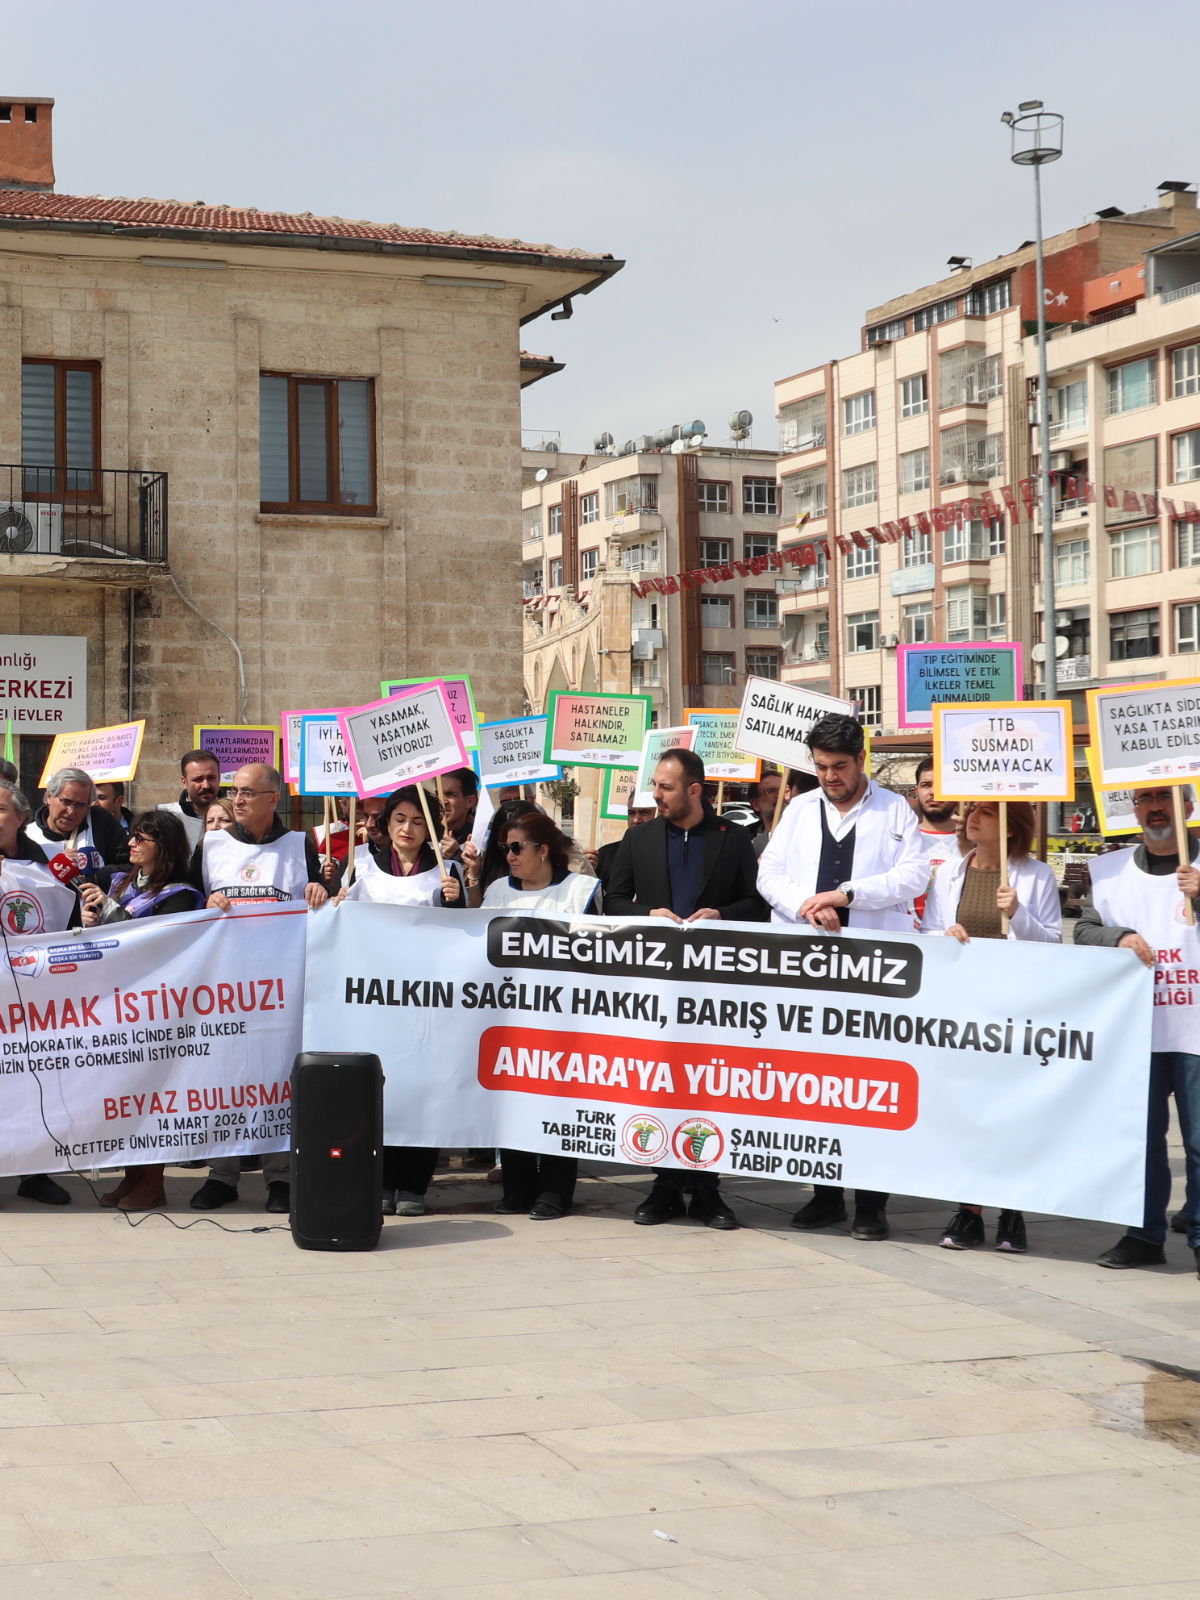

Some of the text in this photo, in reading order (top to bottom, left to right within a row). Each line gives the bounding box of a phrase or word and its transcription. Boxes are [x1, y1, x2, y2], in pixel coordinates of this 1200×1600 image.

[923, 652, 997, 664] TIP EĞİTİMİNDE
[919, 665, 1001, 677] BİLİMSEL VE ETİK
[924, 679, 995, 690] İLKELER TEMEL
[750, 693, 794, 715] SAĞLIK
[930, 692, 991, 702] ALINMALIDIR
[369, 703, 425, 729] YAŞAMAK,
[571, 704, 630, 717] HASTANELER
[1110, 701, 1172, 719] SAĞLIKTA
[372, 718, 431, 746] YAŞATMAK
[574, 718, 626, 732] HALKINDIR,
[988, 718, 1015, 732] TTB
[1114, 722, 1148, 736] YASA
[319, 727, 333, 740] İYİ
[494, 726, 535, 740] SAĞLIKTA
[570, 731, 628, 745] SATILAMAZ!
[205, 737, 268, 745] HAYATLARIMIZDAN
[377, 734, 434, 761] İSTİYORUZ!
[502, 739, 529, 752] ŞİDDET
[972, 738, 1034, 752] SUSMADI
[1121, 737, 1162, 752] KABUL
[492, 750, 542, 765] SONA ERSİN!
[716, 750, 746, 760] İSTİYORUZ
[953, 758, 1053, 772] SUSMAYACAK
[616, 783, 628, 794] BİR
[226, 885, 267, 897] BİR SAĞLIK
[69, 953, 78, 961] BİR
[78, 951, 101, 960] TÜRKİYE
[501, 930, 908, 986] EMEĞİMİZ, MESLEĞİMİZ
[113, 978, 286, 1025] İSTİYORUZ!
[345, 976, 1094, 1066] HALKIN SAĞLIK HAKKI, BARIŞ VE DEMOKRASİ İÇİN
[3, 1034, 89, 1057] DEMOKRATİK,
[92, 1031, 128, 1049] BARIŞ
[131, 1026, 174, 1045] İÇİNDE
[177, 1022, 196, 1039] BİR
[201, 1020, 247, 1037] ÜLKEDE
[28, 1055, 70, 1073] DEĞER
[74, 1047, 144, 1067] GÖRMESİNİ
[148, 1042, 211, 1062] İSTİYORUZ
[492, 1045, 900, 1114] ANKARA'YA YÜRÜYORUZ!
[103, 1080, 291, 1121] BEYAZ BULUŞMA
[157, 1110, 258, 1132] 14 MART 2026 /
[576, 1109, 616, 1126] TÜRK
[541, 1121, 617, 1143] TABİPLERİ
[54, 1128, 232, 1158] HACETTEPE ÜNİVERSİTESİ TIP
[560, 1138, 616, 1158] BİRLİĞİ
[729, 1128, 843, 1157] ŞANLIURFA
[728, 1150, 843, 1181] TABİP ODASI
